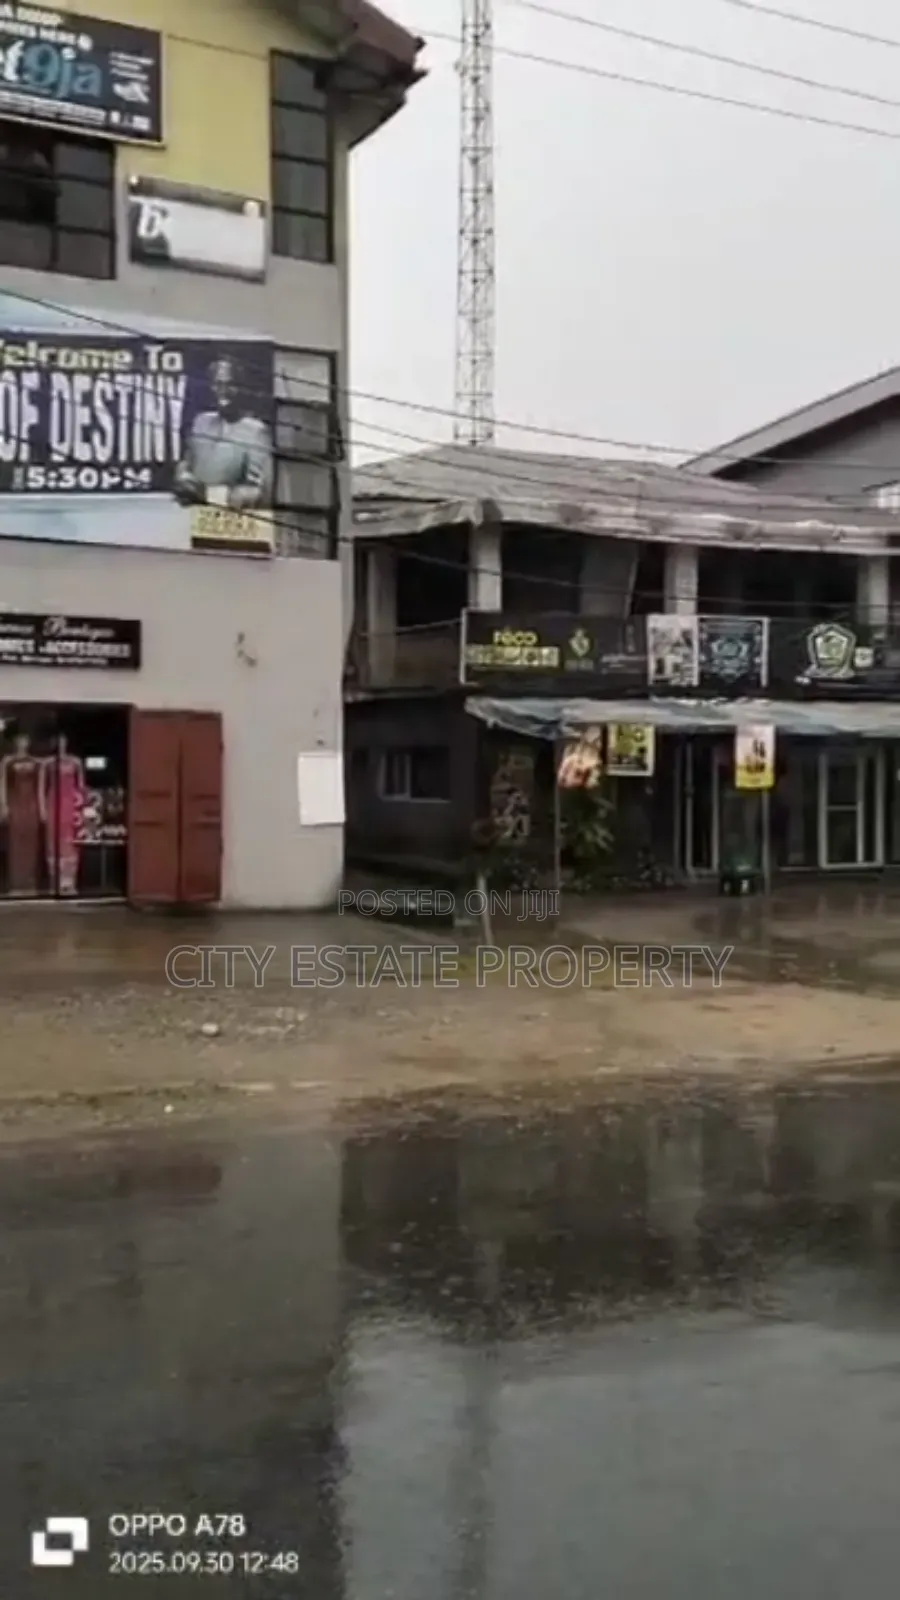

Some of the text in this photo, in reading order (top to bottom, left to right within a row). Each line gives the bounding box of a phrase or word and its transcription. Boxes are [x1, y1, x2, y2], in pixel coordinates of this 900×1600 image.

[0, 40, 102, 98] t9ja
[0, 340, 183, 372] elcome To
[50, 372, 187, 462] DESTINY
